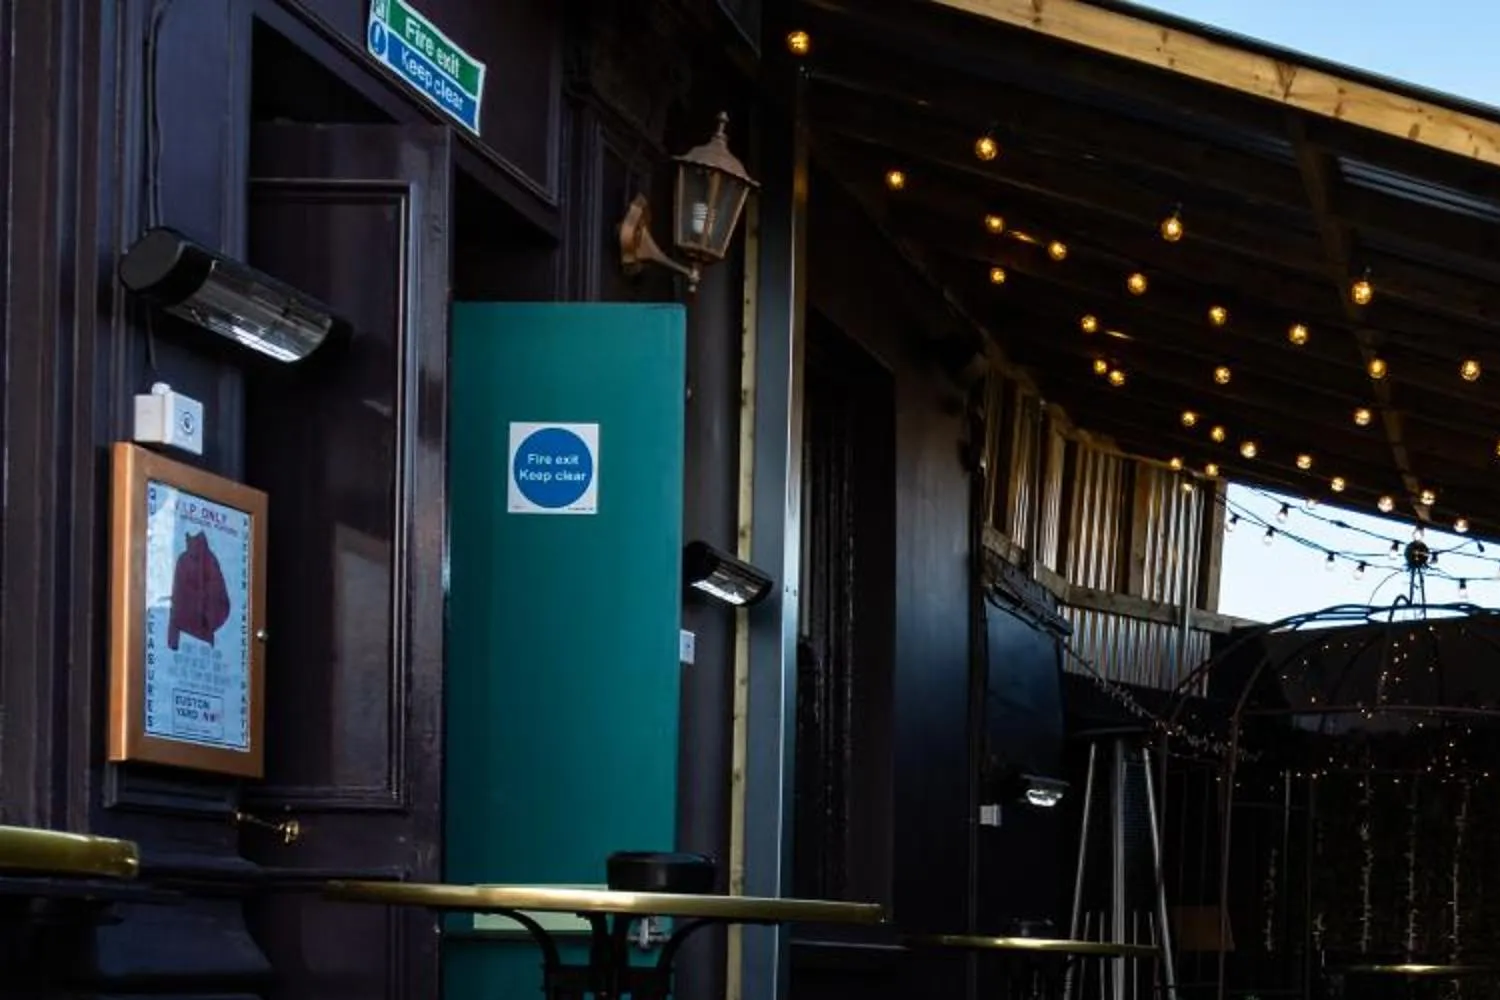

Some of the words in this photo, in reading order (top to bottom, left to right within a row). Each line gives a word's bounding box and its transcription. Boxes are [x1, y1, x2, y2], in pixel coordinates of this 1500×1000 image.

[405, 17, 435, 57] Fire
[436, 48, 460, 79] exit
[401, 46, 433, 90] Keep
[434, 79, 464, 111] clear
[527, 453, 553, 465] Fire
[555, 453, 579, 465] exit
[519, 469, 553, 484] Keep
[555, 469, 586, 481] clear
[175, 695, 211, 710] EUSTON
[176, 707, 200, 721] YARD
